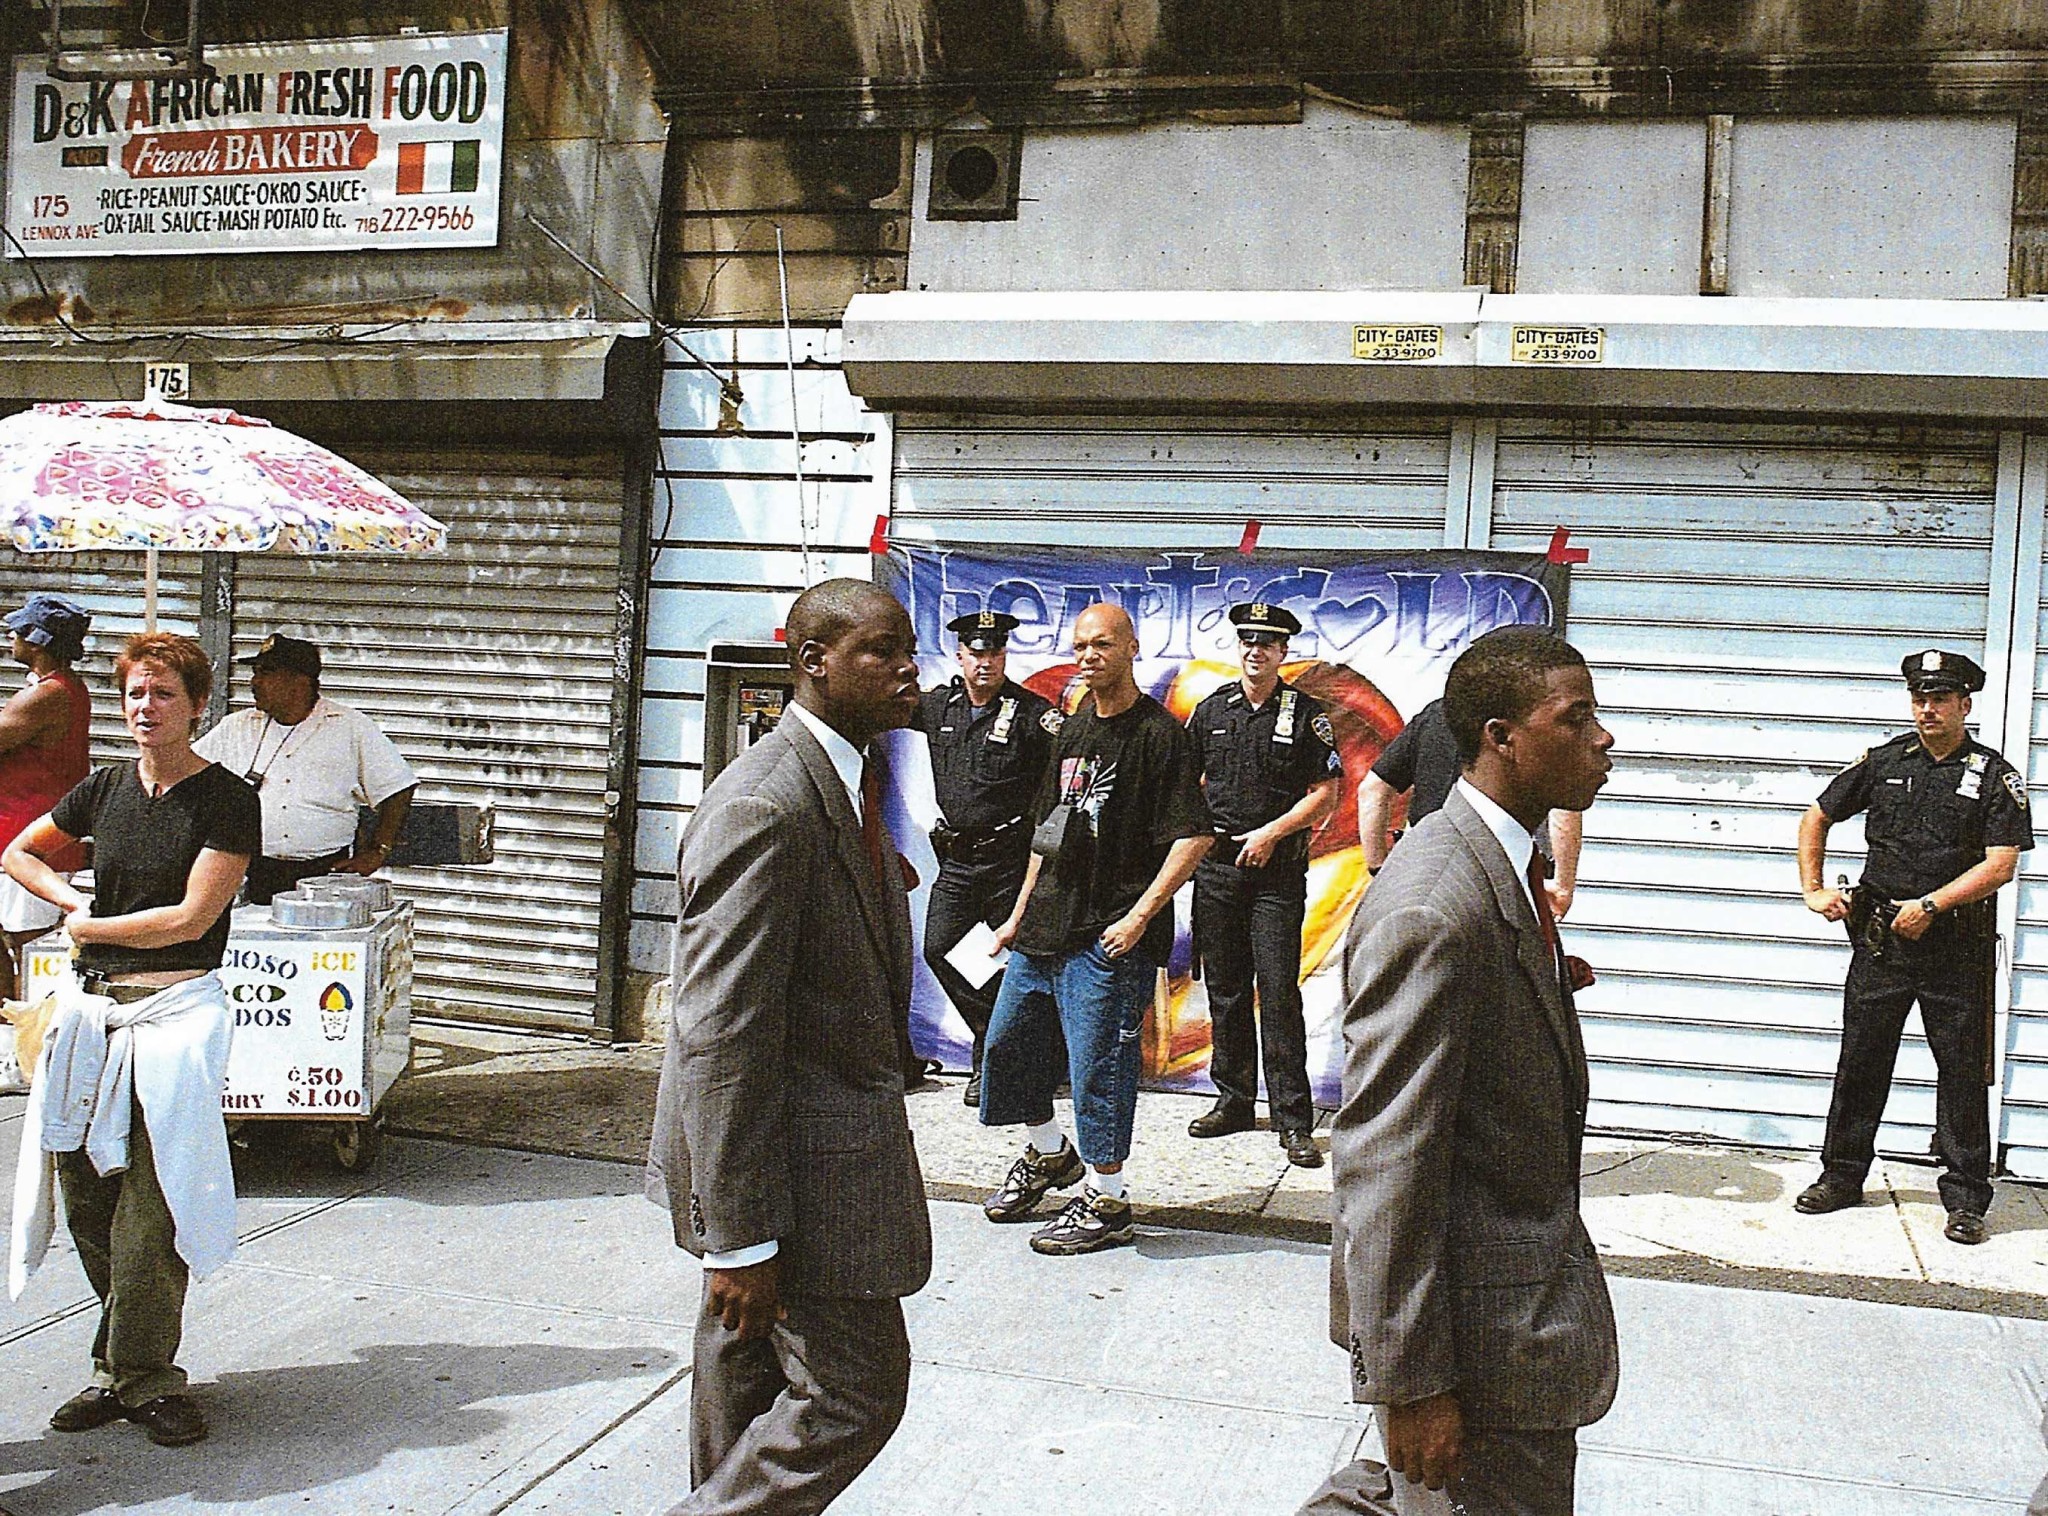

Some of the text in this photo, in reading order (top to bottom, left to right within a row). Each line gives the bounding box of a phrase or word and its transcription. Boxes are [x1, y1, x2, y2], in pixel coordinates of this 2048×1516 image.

[34, 61, 487, 143] D&K AFRICAN FRESH FOOD
[132, 129, 361, 175] French BAKERY
[33, 195, 70, 218] 175
[264, 207, 318, 230] POTATO
[355, 205, 474, 234] 718 222-9566
[22, 223, 99, 241] LENNOX AVE
[1357, 329, 1438, 343] CITY-GATES
[1516, 329, 1599, 344] CITY-GATES
[148, 368, 182, 393] 175
